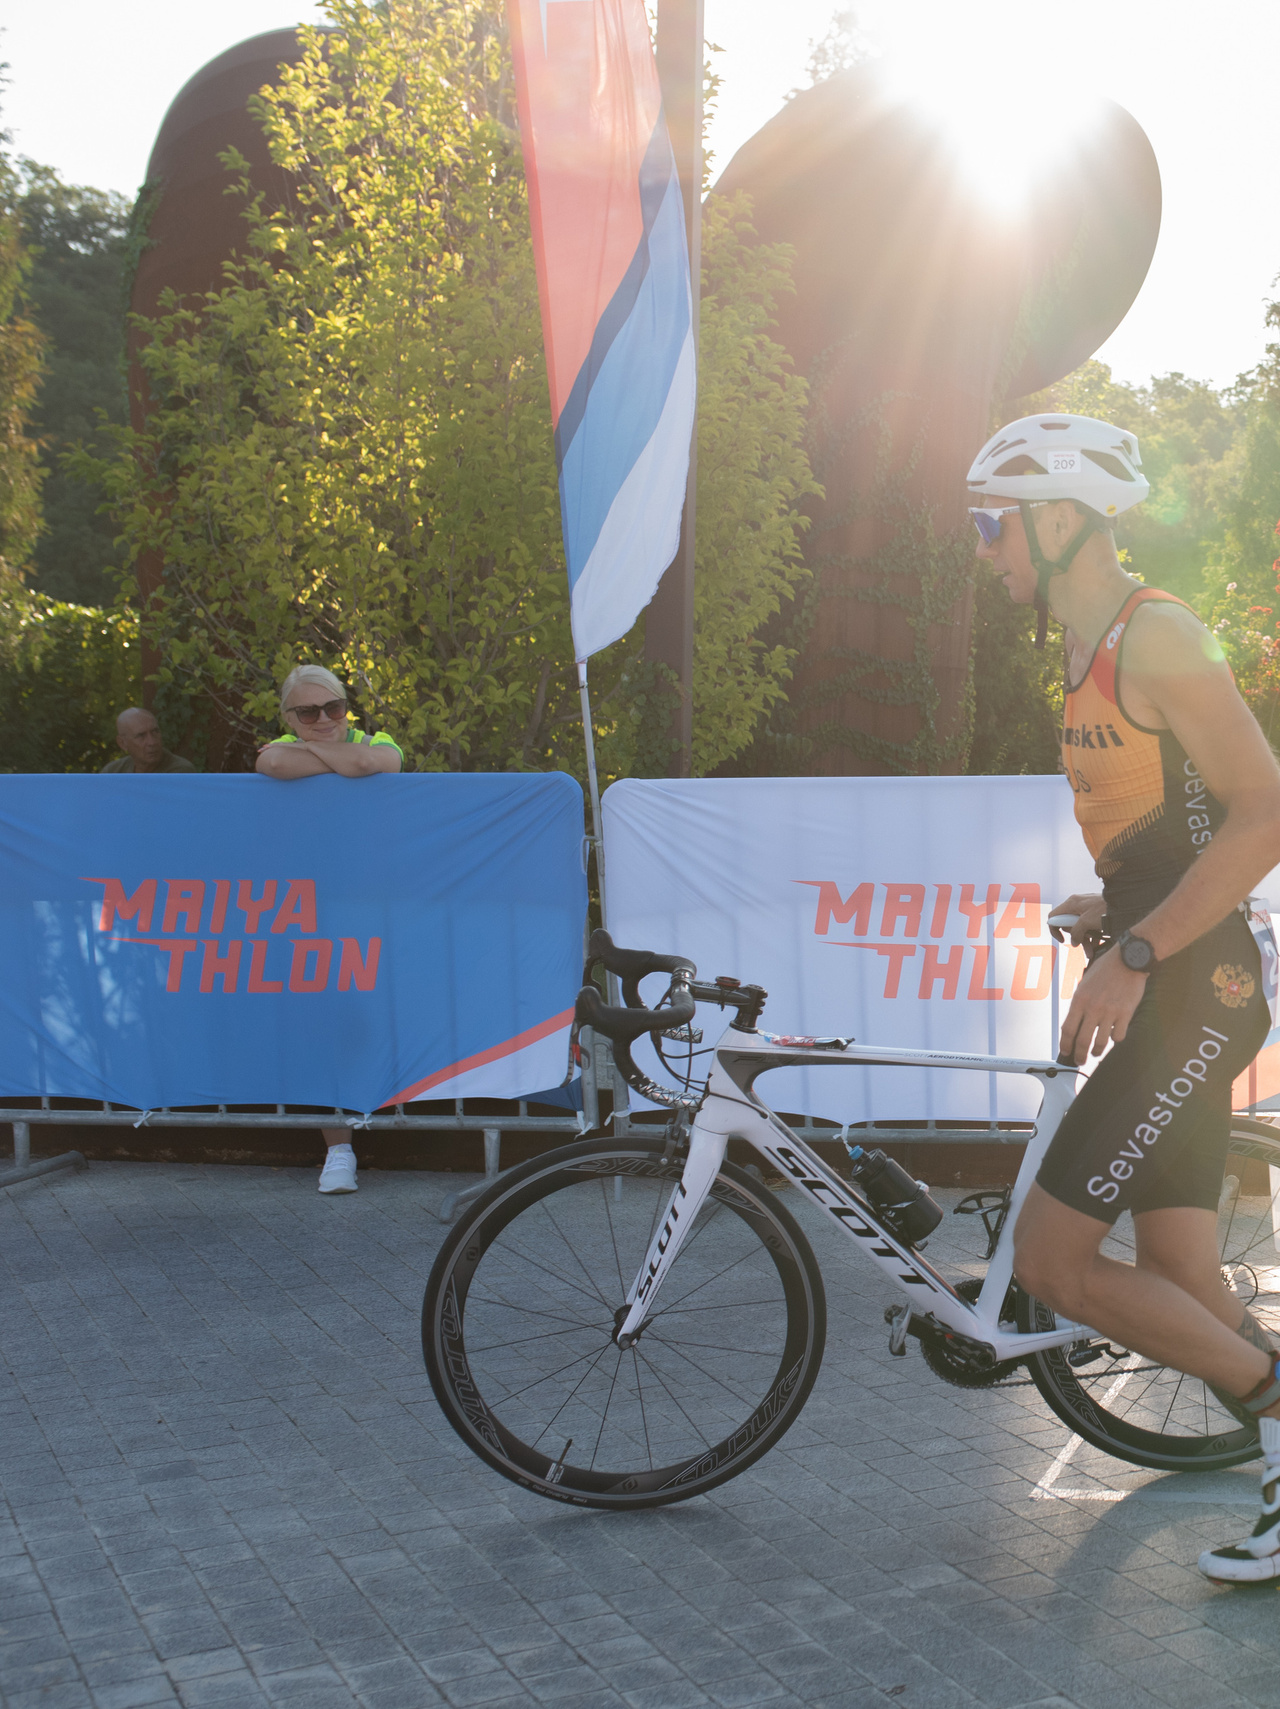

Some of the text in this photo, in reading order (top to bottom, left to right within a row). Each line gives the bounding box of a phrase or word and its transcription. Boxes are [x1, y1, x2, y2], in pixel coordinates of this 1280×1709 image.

[1054, 459, 1076, 470] 209
[77, 877, 318, 934] MRIYA
[789, 880, 1042, 939] MRIYA
[104, 937, 382, 993] THLON
[1087, 1025, 1230, 1203] Sevastopol
[764, 1146, 939, 1293] SCOTT
